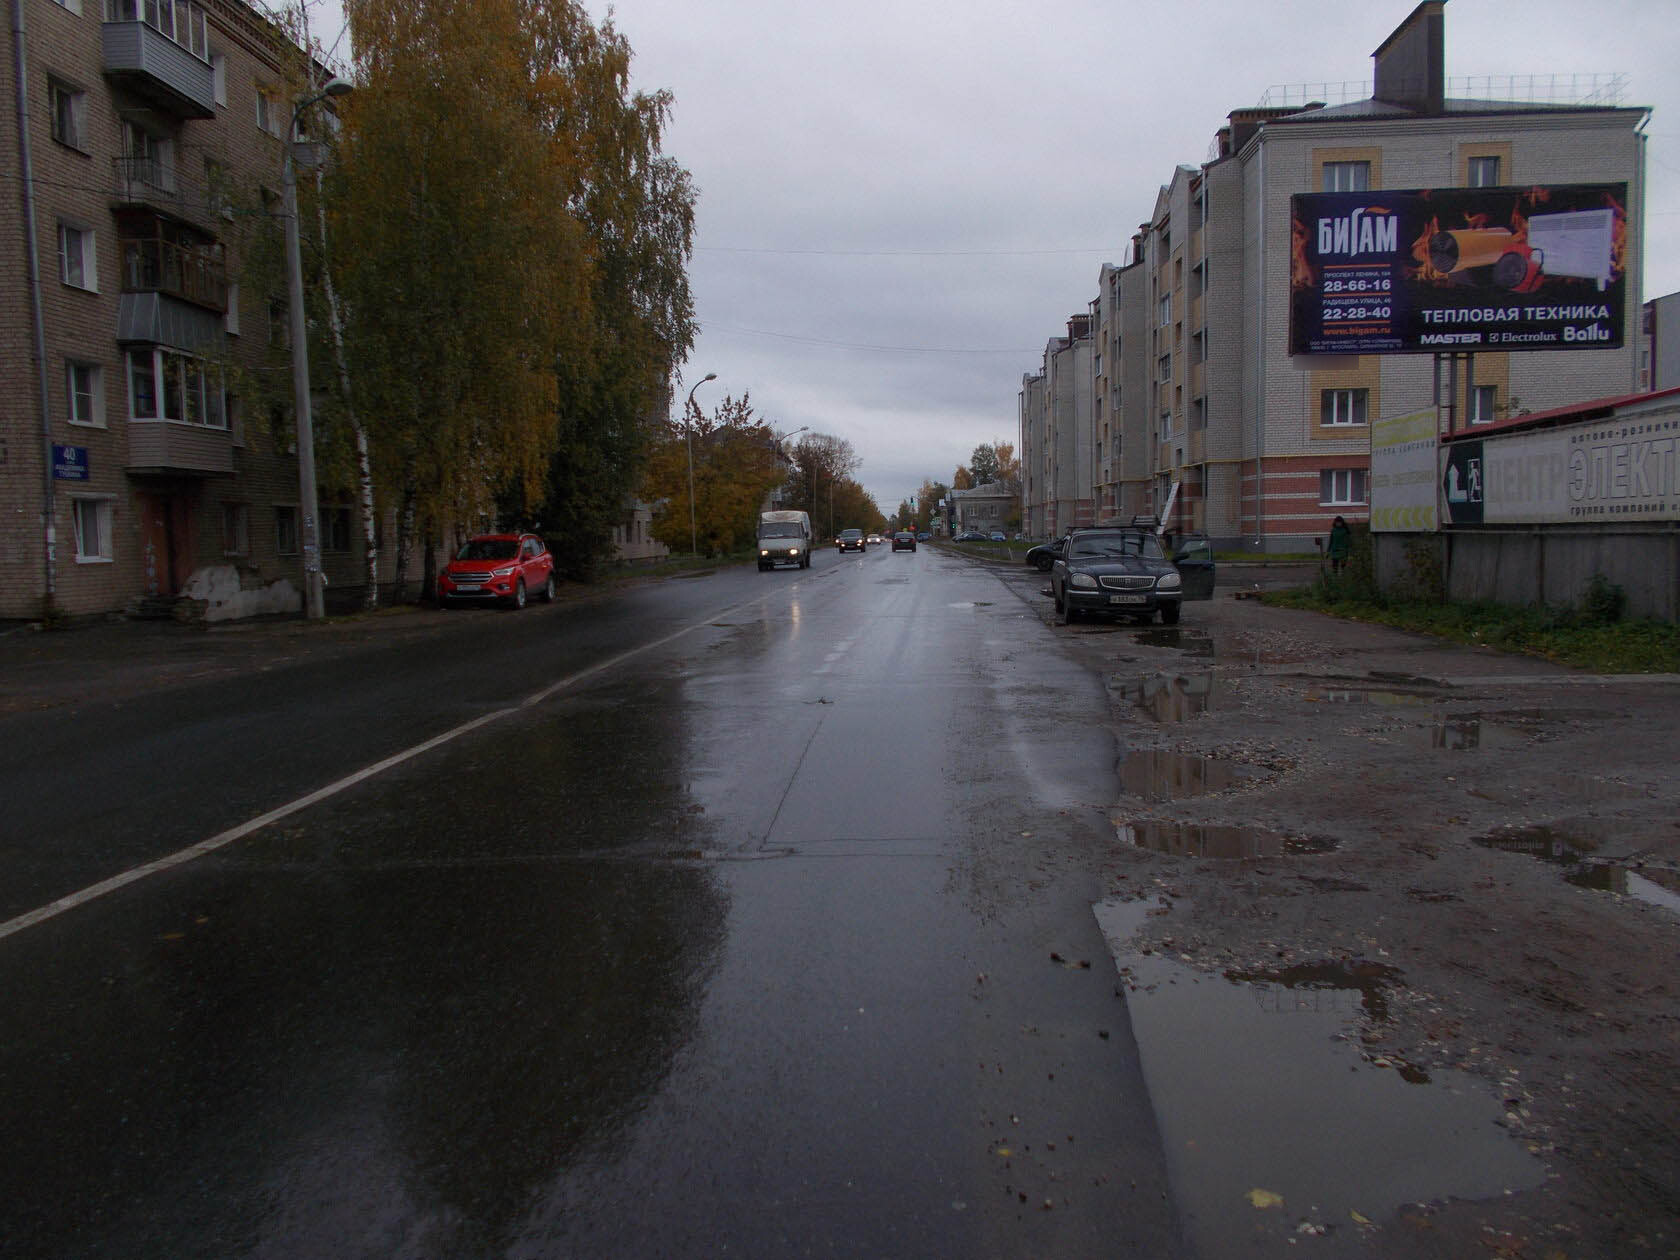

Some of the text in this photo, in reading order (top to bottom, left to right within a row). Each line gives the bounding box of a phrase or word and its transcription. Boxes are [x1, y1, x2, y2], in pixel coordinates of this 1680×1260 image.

[1318, 207, 1398, 257] БИГАМ
[1323, 279, 1391, 292] 28-66-16
[1322, 306, 1391, 320] 22-28-40
[1422, 304, 1610, 323] ТЕПЛОВАЯ ТЕХНИКА
[1323, 327, 1391, 336] www.bigam.ru
[1501, 332, 1557, 343] Electrolux
[1563, 322, 1610, 342] Ballu
[1420, 333, 1482, 345] MASTER
[64, 447, 76, 461] 40
